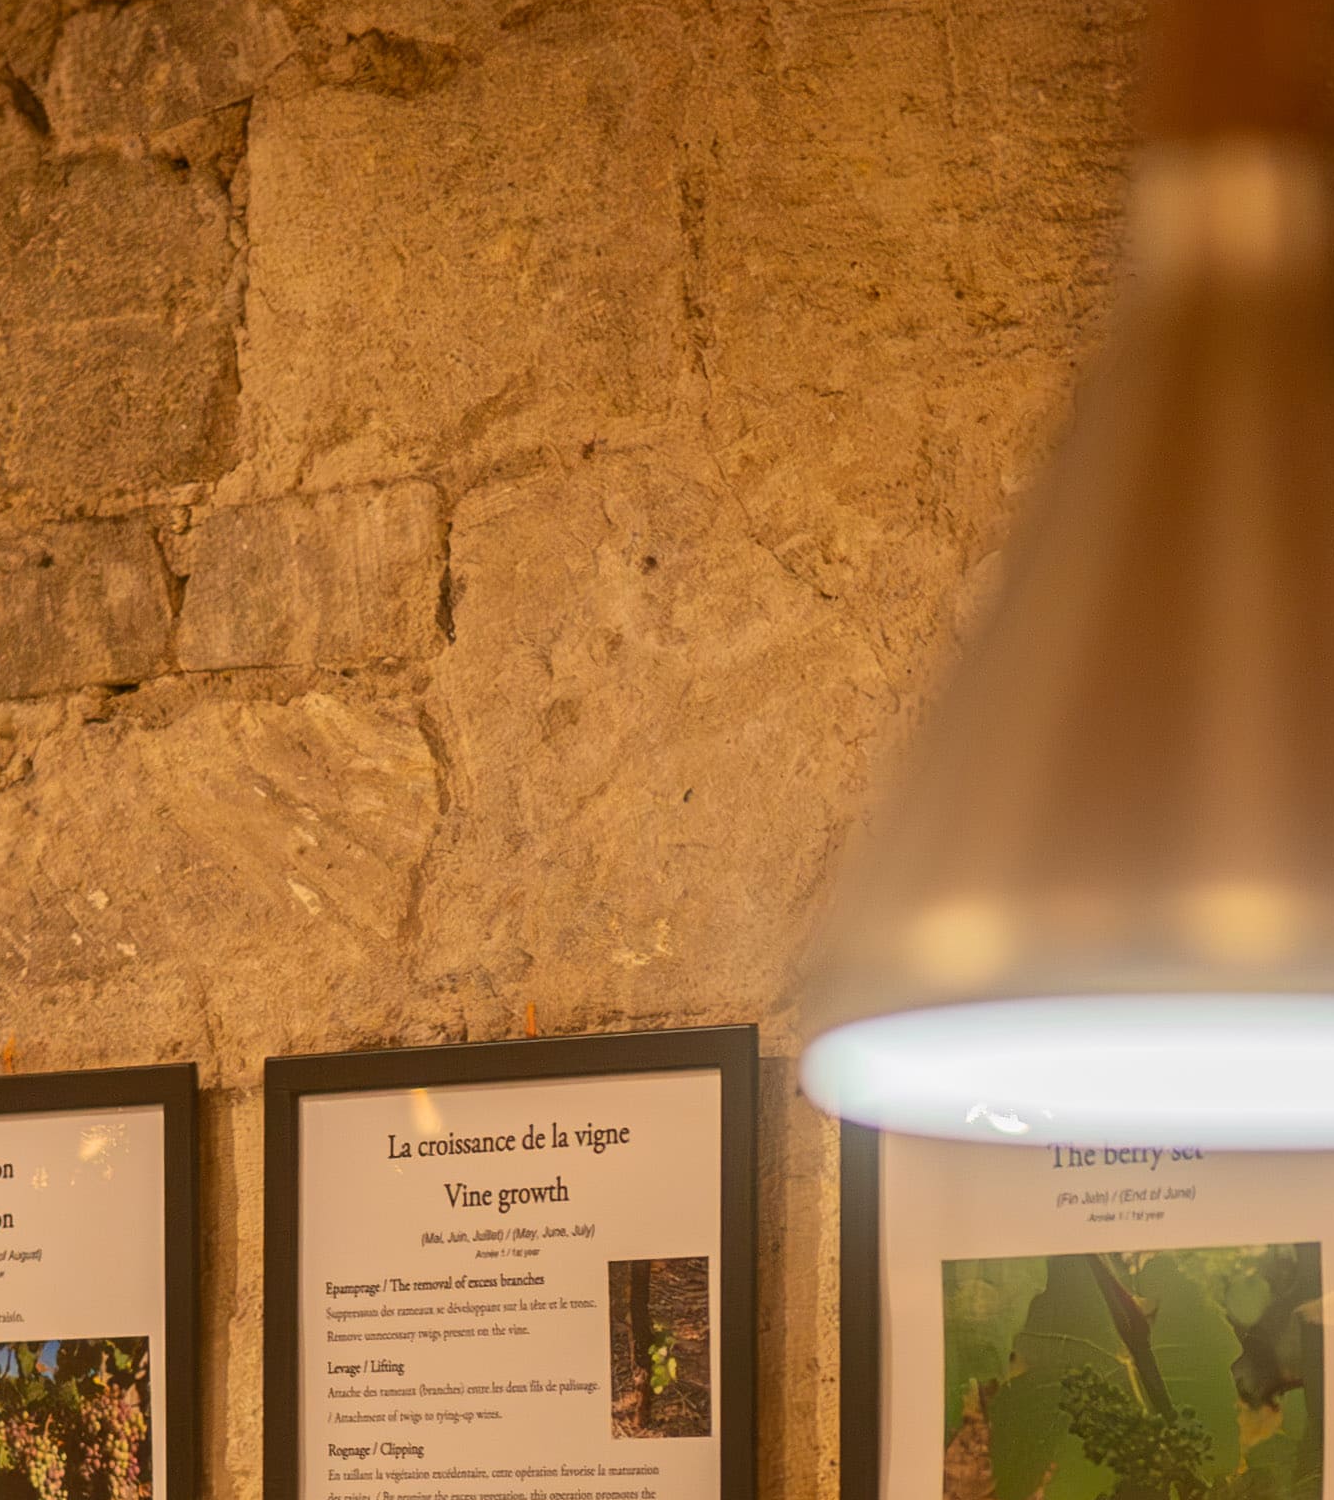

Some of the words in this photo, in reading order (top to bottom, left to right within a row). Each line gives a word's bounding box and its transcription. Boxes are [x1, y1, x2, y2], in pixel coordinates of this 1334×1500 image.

[387, 1134, 412, 1158] La
[417, 1132, 515, 1156] croissance
[521, 1123, 545, 1150] de
[551, 1122, 569, 1148] la
[574, 1122, 629, 1154] vigne
[444, 1182, 491, 1207] Vine
[498, 1175, 569, 1213] growth
[325, 1281, 380, 1298] Epamprage
[389, 1278, 410, 1292] The
[413, 1276, 452, 1290] removal
[454, 1274, 466, 1288] of
[466, 1276, 497, 1288] excess
[500, 1271, 544, 1286] branches
[327, 1361, 361, 1377] Levage
[370, 1358, 404, 1376] Lifting
[328, 1443, 370, 1460] Rognage
[379, 1442, 424, 1459] Clipping
